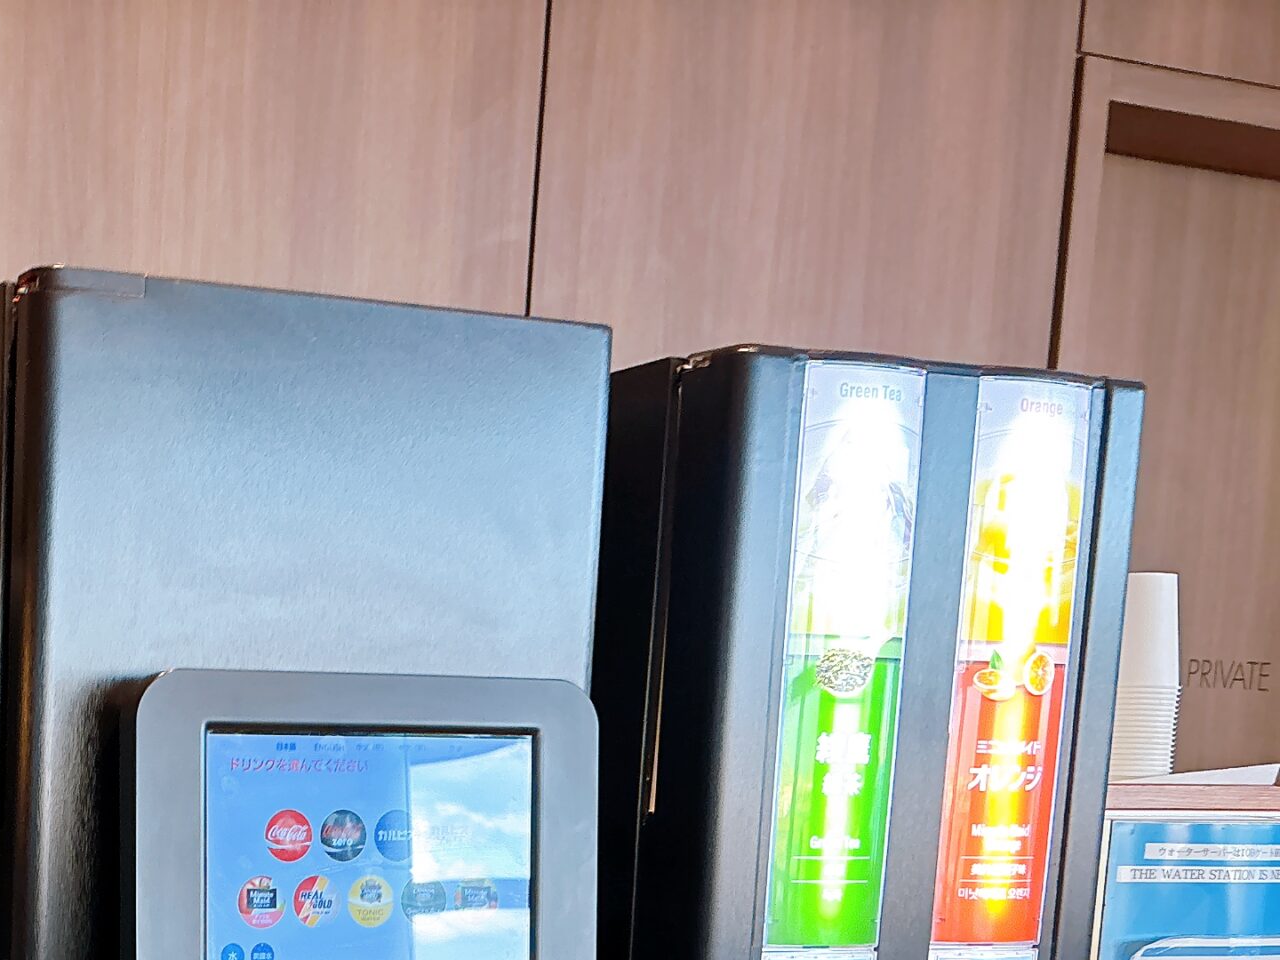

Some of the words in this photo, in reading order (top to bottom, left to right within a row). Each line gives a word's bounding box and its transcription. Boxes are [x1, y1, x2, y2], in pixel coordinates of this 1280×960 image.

[839, 382, 879, 399] Green
[882, 385, 902, 402] Tea
[1020, 398, 1063, 416] Orange
[1186, 658, 1271, 692] PRIVATE
[230, 758, 368, 773] ドリンクを選んでください
[377, 830, 413, 842] カルピ
[1130, 869, 1157, 880] THE
[1161, 869, 1206, 880] WATER
[1208, 869, 1256, 881] STATION
[1258, 869, 1268, 880] IS
[300, 891, 323, 900] REAL
[312, 899, 333, 908] GOLD
[228, 952, 238, 960] 水
